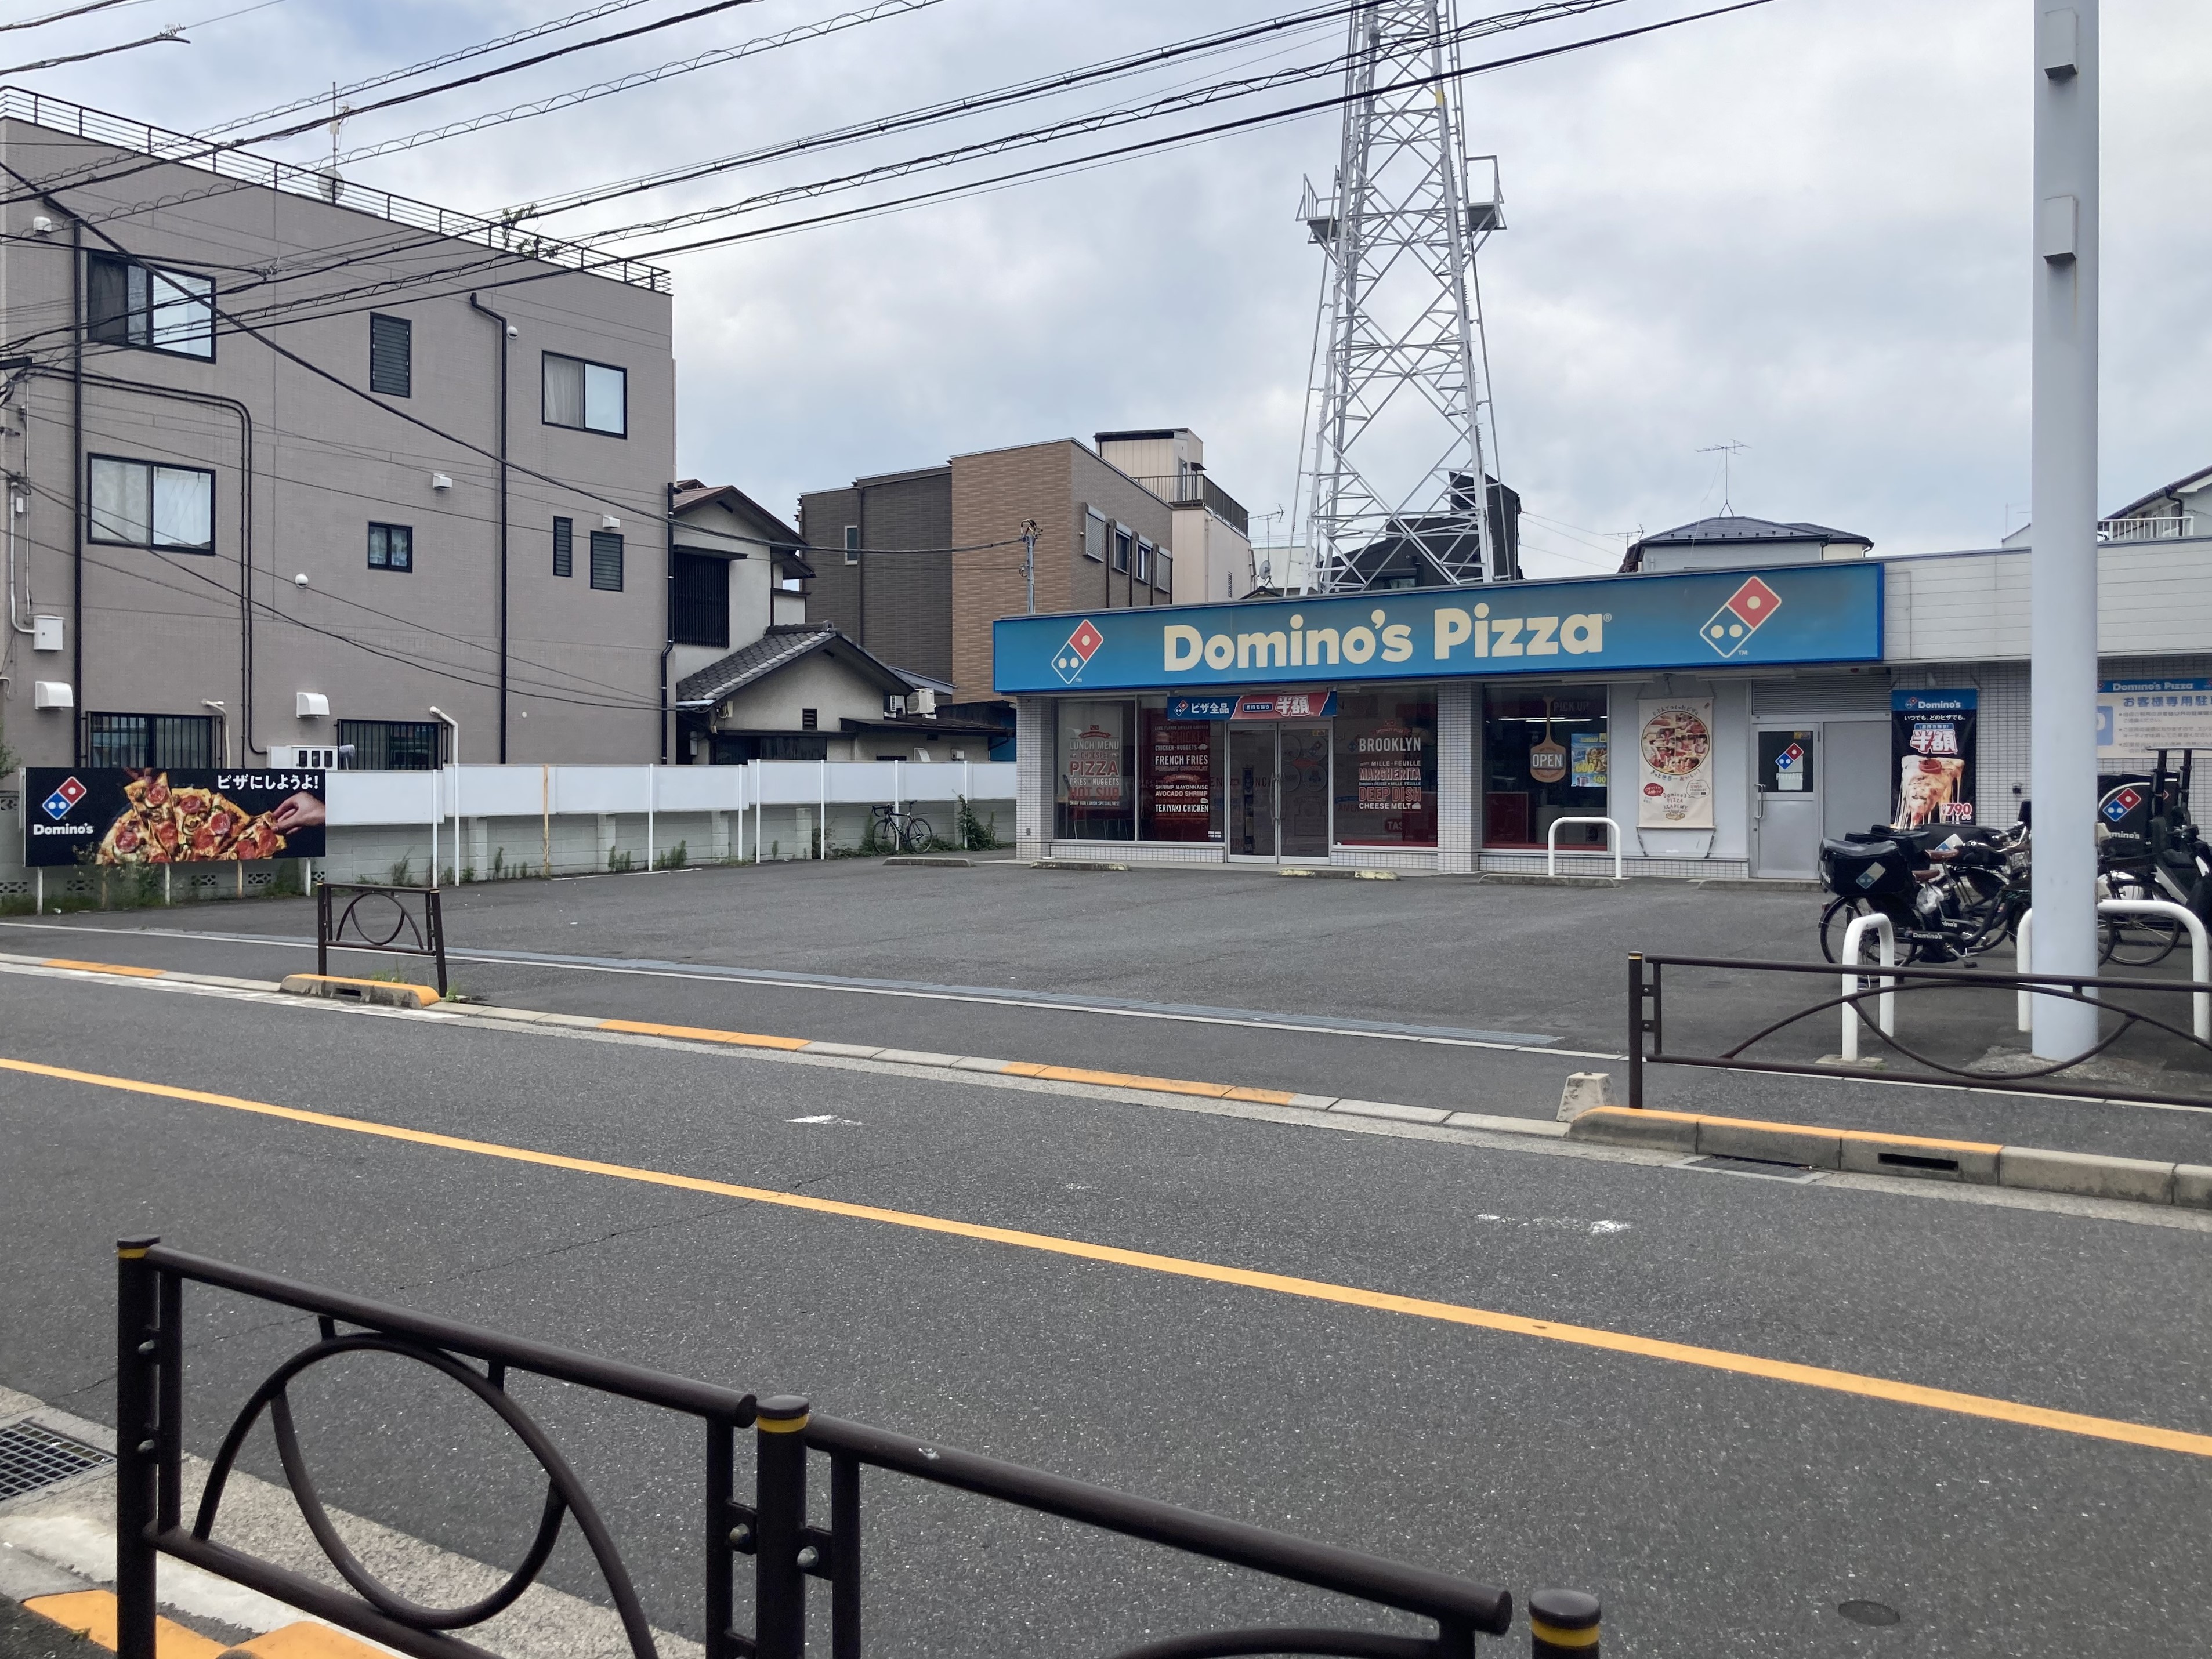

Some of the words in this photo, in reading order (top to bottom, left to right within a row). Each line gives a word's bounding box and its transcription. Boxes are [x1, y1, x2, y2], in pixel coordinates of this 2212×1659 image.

[1164, 609, 1413, 672] Domino's
[1434, 603, 1603, 660] Pizza
[2112, 682, 2161, 691] Domino's
[2164, 682, 2193, 690] Pizza
[1191, 702, 1229, 714] ピザ全品
[1276, 696, 1309, 715] 半額
[1918, 700, 1961, 709] Domino's
[2123, 696, 2212, 707] お客様専用駐
[1070, 741, 1095, 750] LUNCH
[1097, 741, 1120, 750] MENU
[1359, 737, 1421, 752] BROOKLYN
[1911, 730, 1956, 752] 半額
[1155, 755, 1184, 765] FRENCH
[1186, 755, 1208, 765] FRIES
[1532, 754, 1563, 767] OPEN
[1069, 759, 1120, 777] PIZZA
[1359, 767, 1421, 781] MARGHERITA
[218, 774, 318, 791] ピザにしようよ!
[1096, 787, 1120, 800] SUB
[1359, 786, 1391, 802] DEEP
[1392, 786, 1421, 802] DISH
[1155, 804, 1181, 812] TERIYAKI
[1183, 804, 1209, 812] CHICKEN
[34, 822, 94, 835] Domino's
[2109, 831, 2141, 839] mino's
